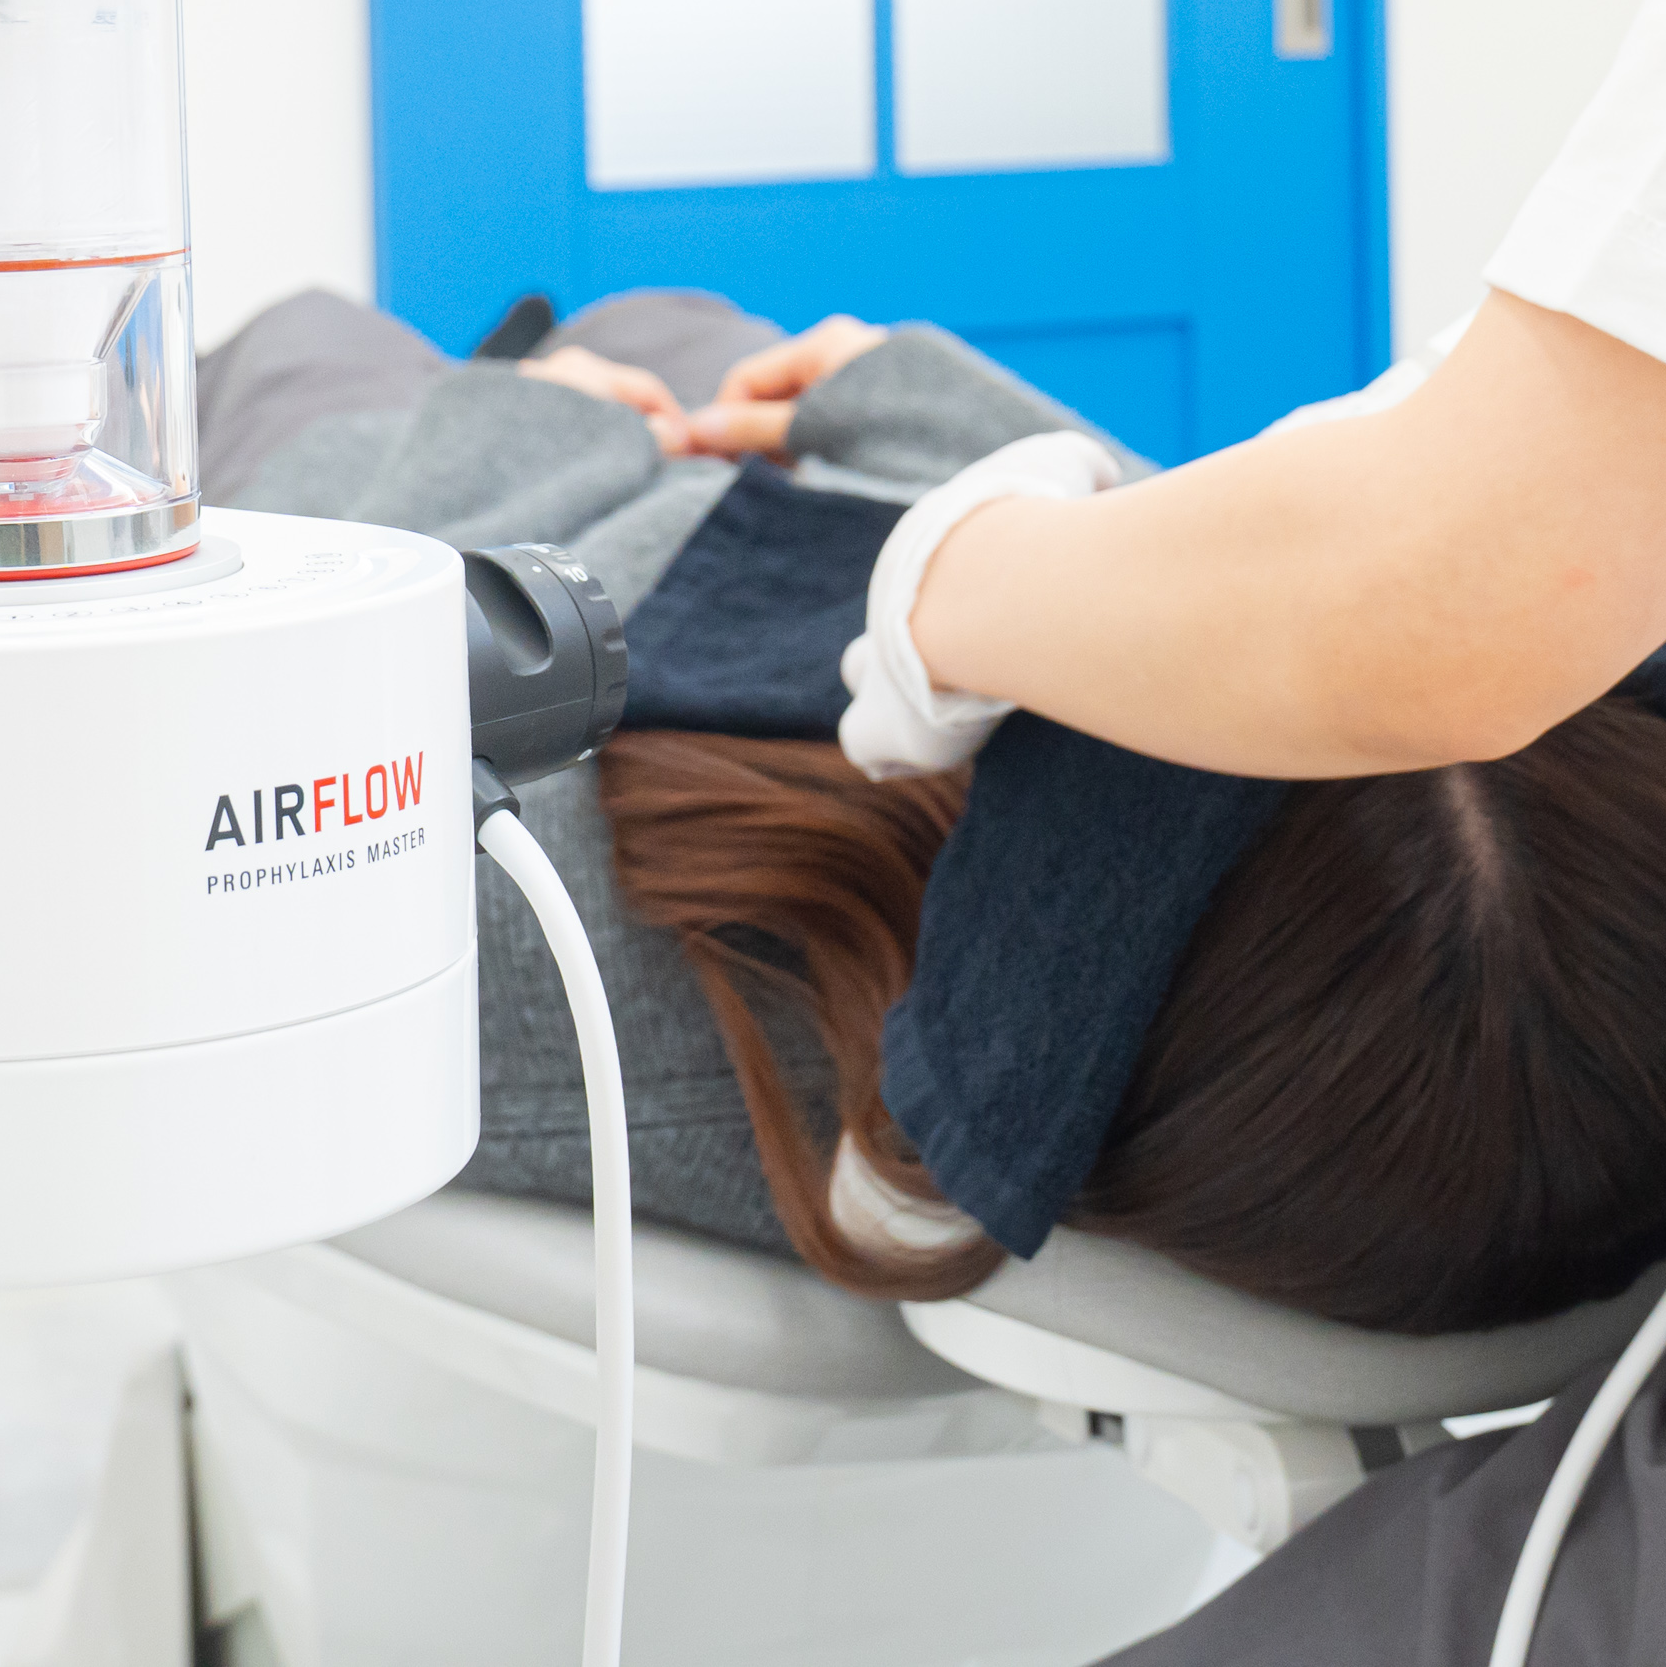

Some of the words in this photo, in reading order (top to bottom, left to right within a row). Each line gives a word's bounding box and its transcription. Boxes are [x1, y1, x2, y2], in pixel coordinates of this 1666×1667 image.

[564, 566, 589, 583] 10
[204, 750, 424, 852] AIRFLOW
[207, 849, 355, 895] PROPHYLAXIS
[366, 826, 425, 864] MASTER
